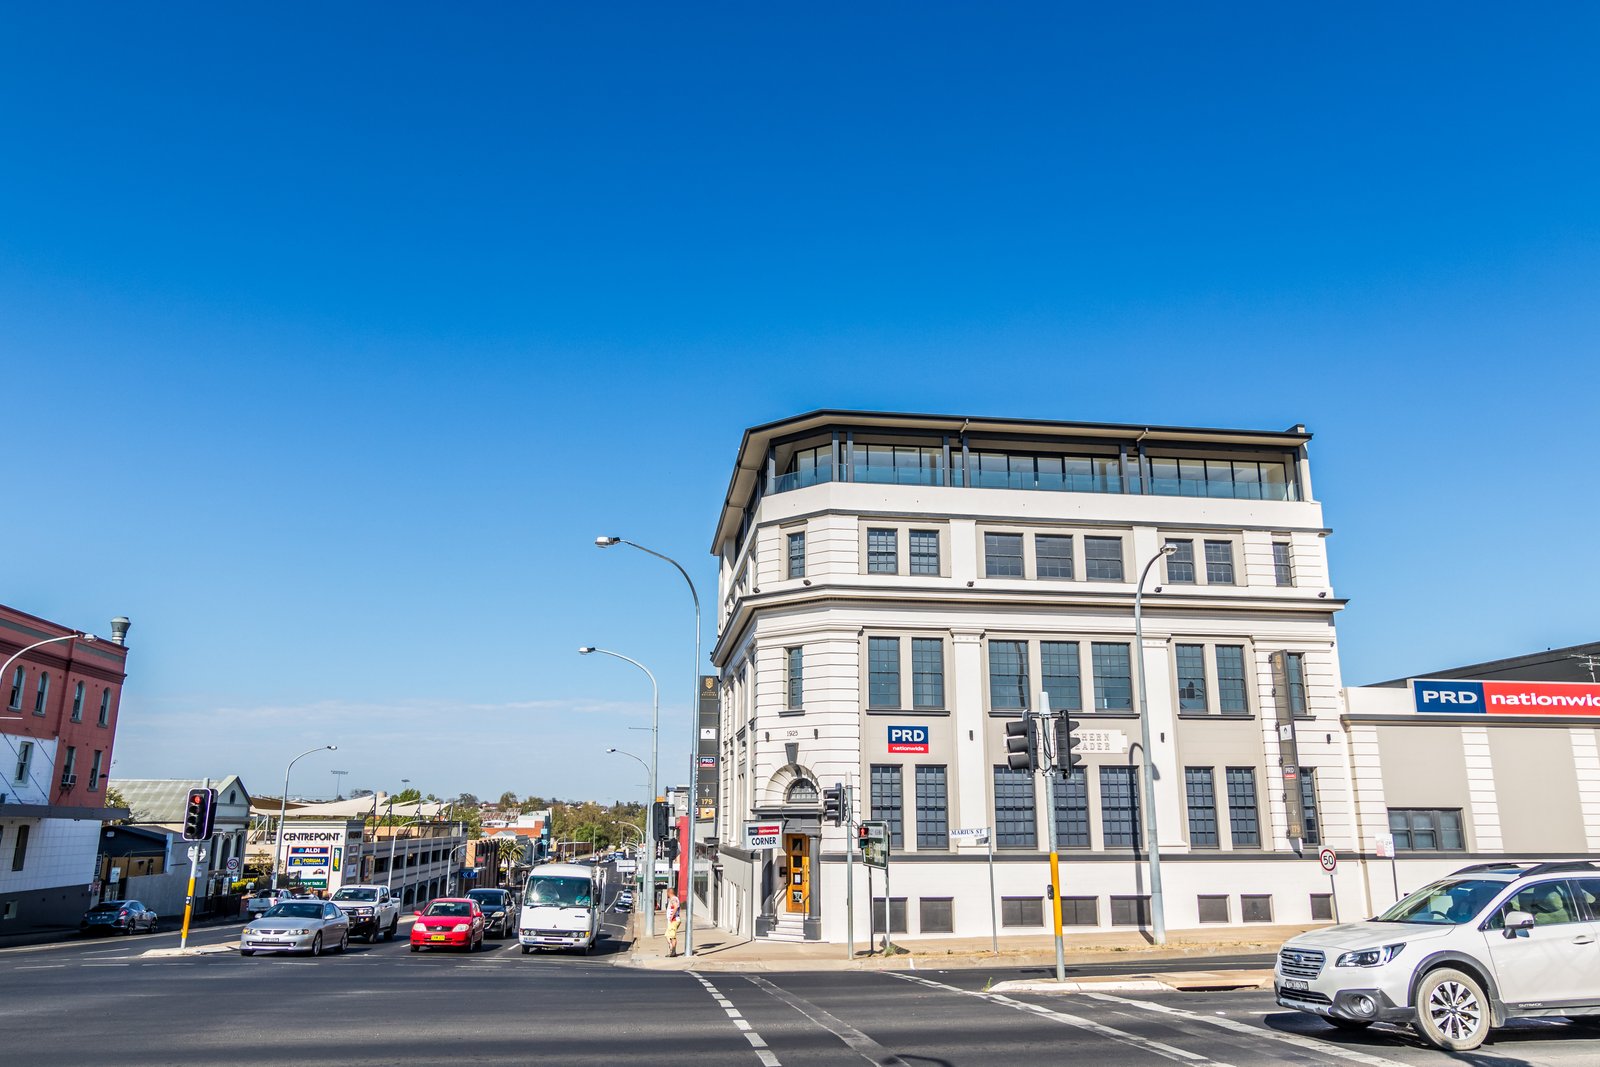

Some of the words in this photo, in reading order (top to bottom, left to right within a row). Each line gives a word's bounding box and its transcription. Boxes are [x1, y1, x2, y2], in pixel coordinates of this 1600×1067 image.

[1422, 690, 1478, 704] PRD
[891, 729, 925, 742] PRD
[283, 832, 341, 841] CENTREPOINT
[751, 836, 777, 846] CORNER
[1322, 855, 1334, 865] 50
